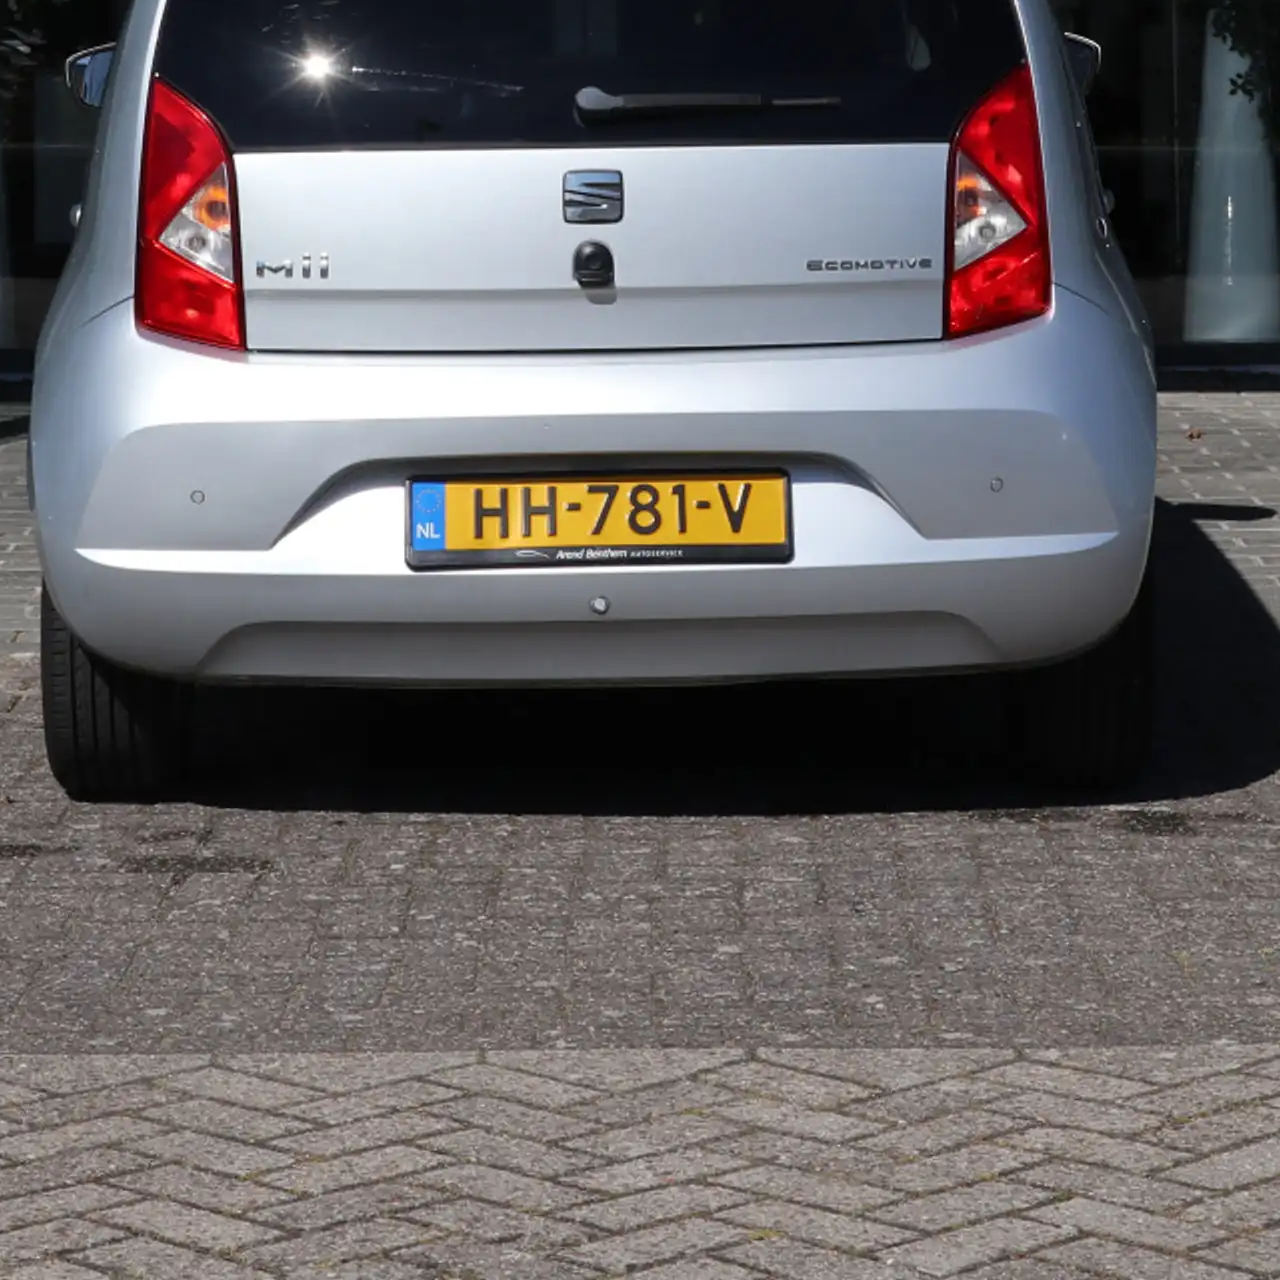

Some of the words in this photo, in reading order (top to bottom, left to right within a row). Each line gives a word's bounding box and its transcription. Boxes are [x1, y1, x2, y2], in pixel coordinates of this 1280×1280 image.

[472, 482, 753, 540] HH-781-V
[415, 522, 441, 539] NL
[555, 547, 585, 560] Arend
[585, 546, 628, 559] Benthem
